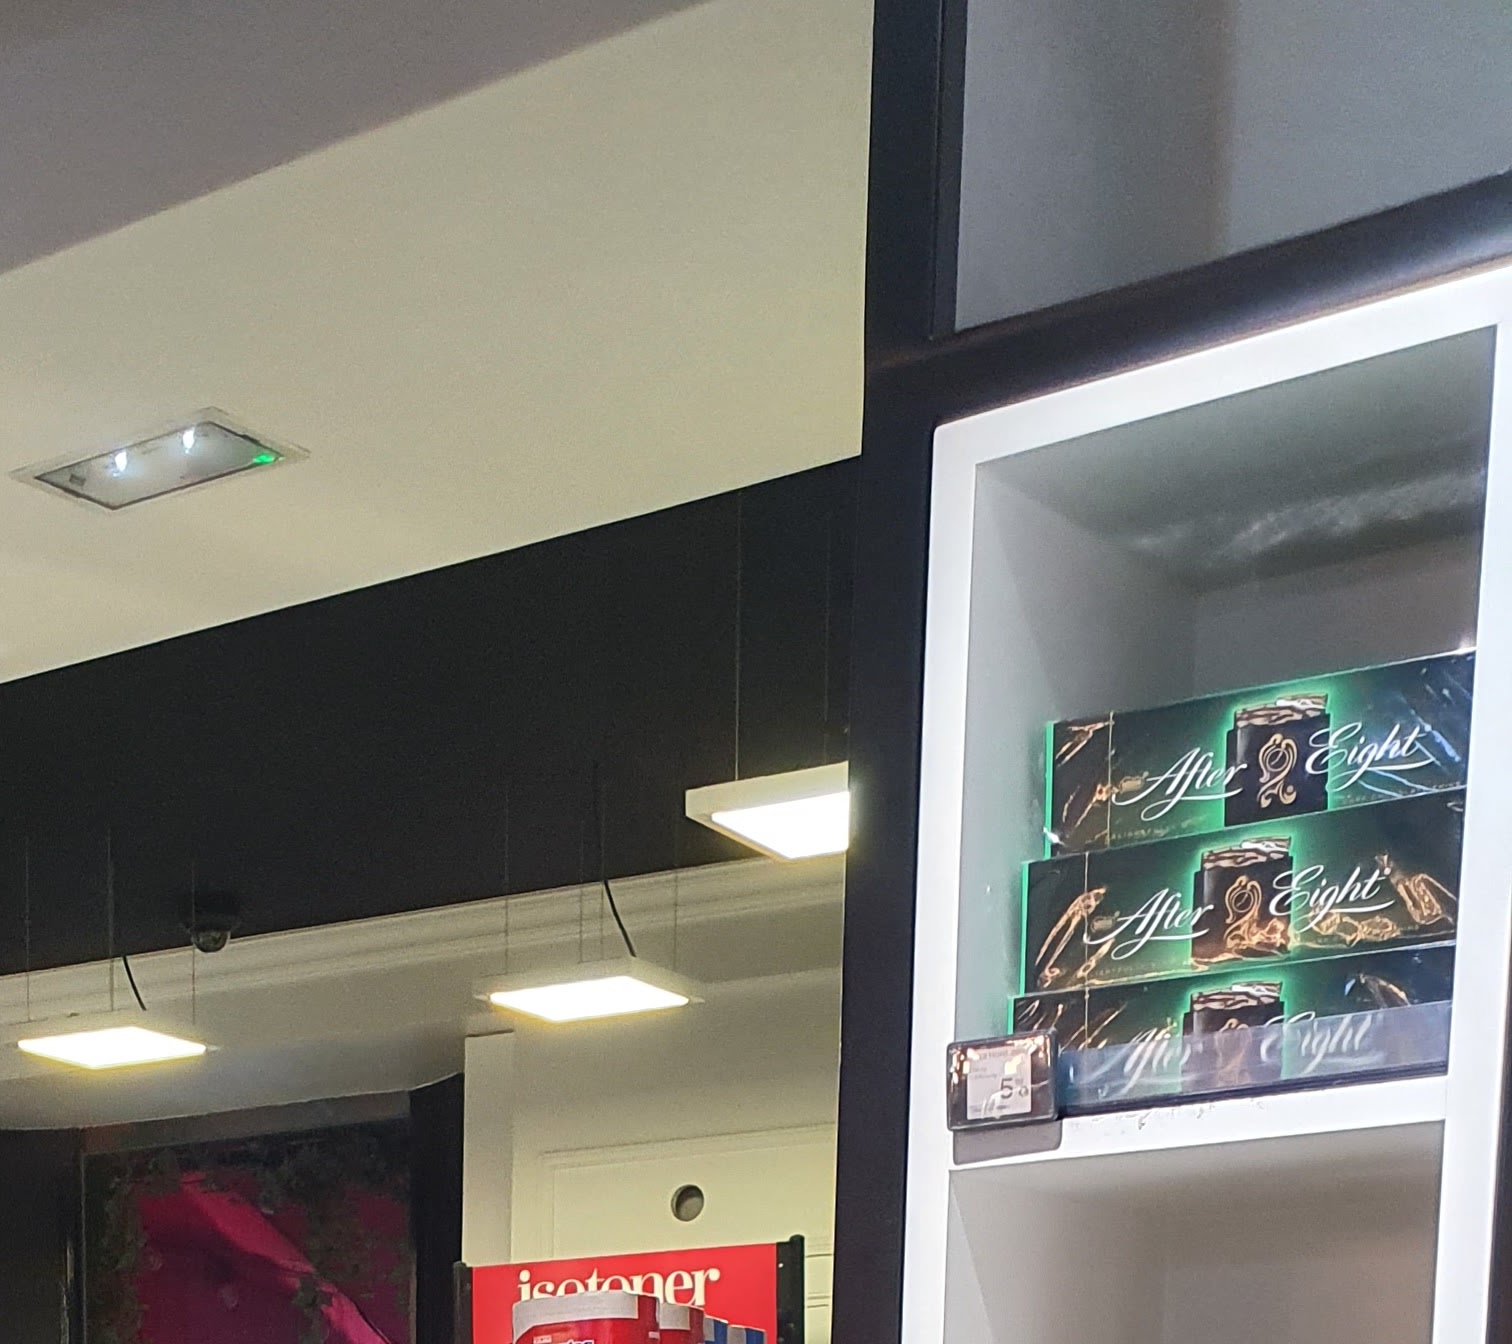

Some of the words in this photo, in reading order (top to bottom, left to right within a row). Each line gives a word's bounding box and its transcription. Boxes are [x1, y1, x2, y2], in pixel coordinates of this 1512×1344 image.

[1112, 747, 1247, 821] After
[1306, 721, 1437, 792] Eight
[1083, 888, 1213, 960] After
[1269, 865, 1394, 933] Eight
